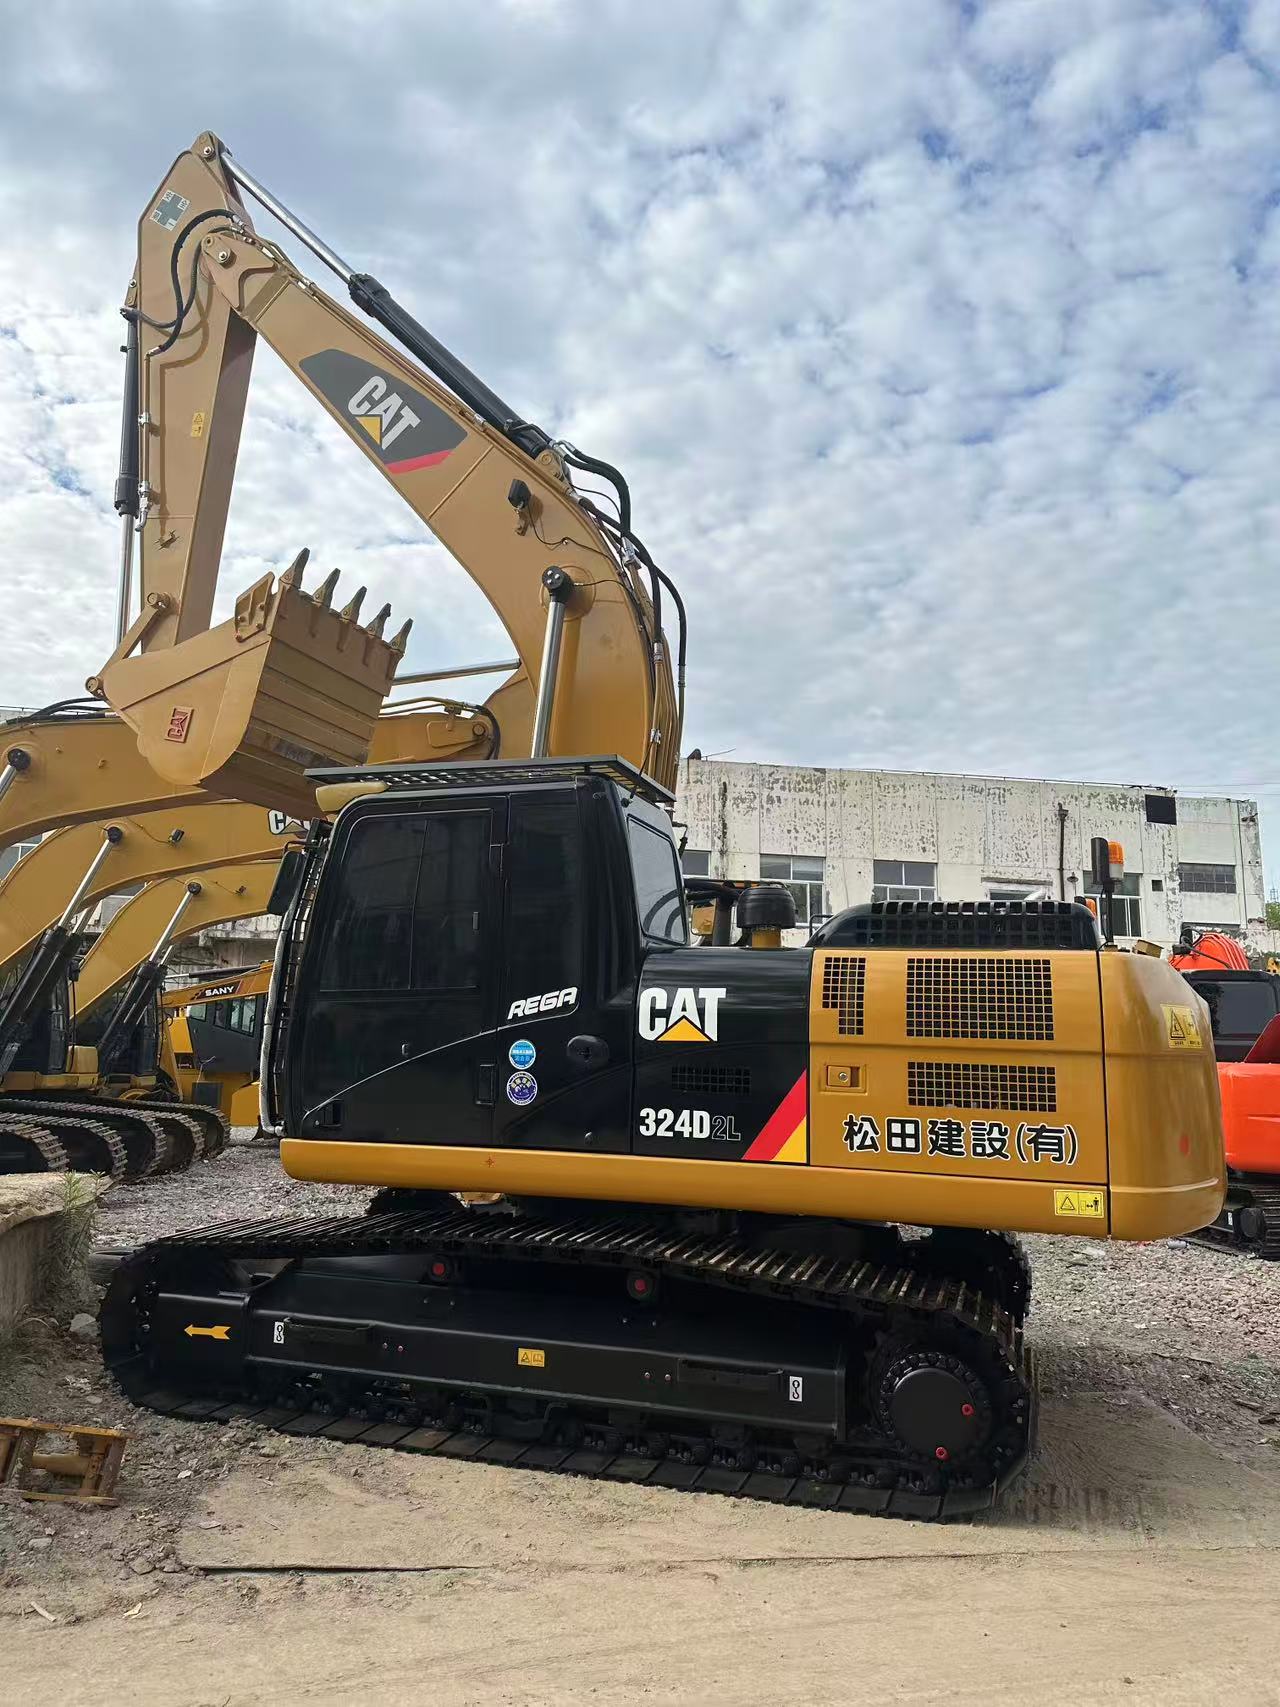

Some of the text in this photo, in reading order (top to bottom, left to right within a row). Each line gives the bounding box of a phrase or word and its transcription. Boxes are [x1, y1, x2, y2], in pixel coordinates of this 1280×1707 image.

[348, 375, 421, 451] CAT
[167, 708, 189, 740] CAT
[205, 986, 234, 997] SANY
[507, 986, 578, 1019] REGA
[639, 987, 727, 1042] CAT
[842, 1113, 1079, 1165] 松田建設(有)
